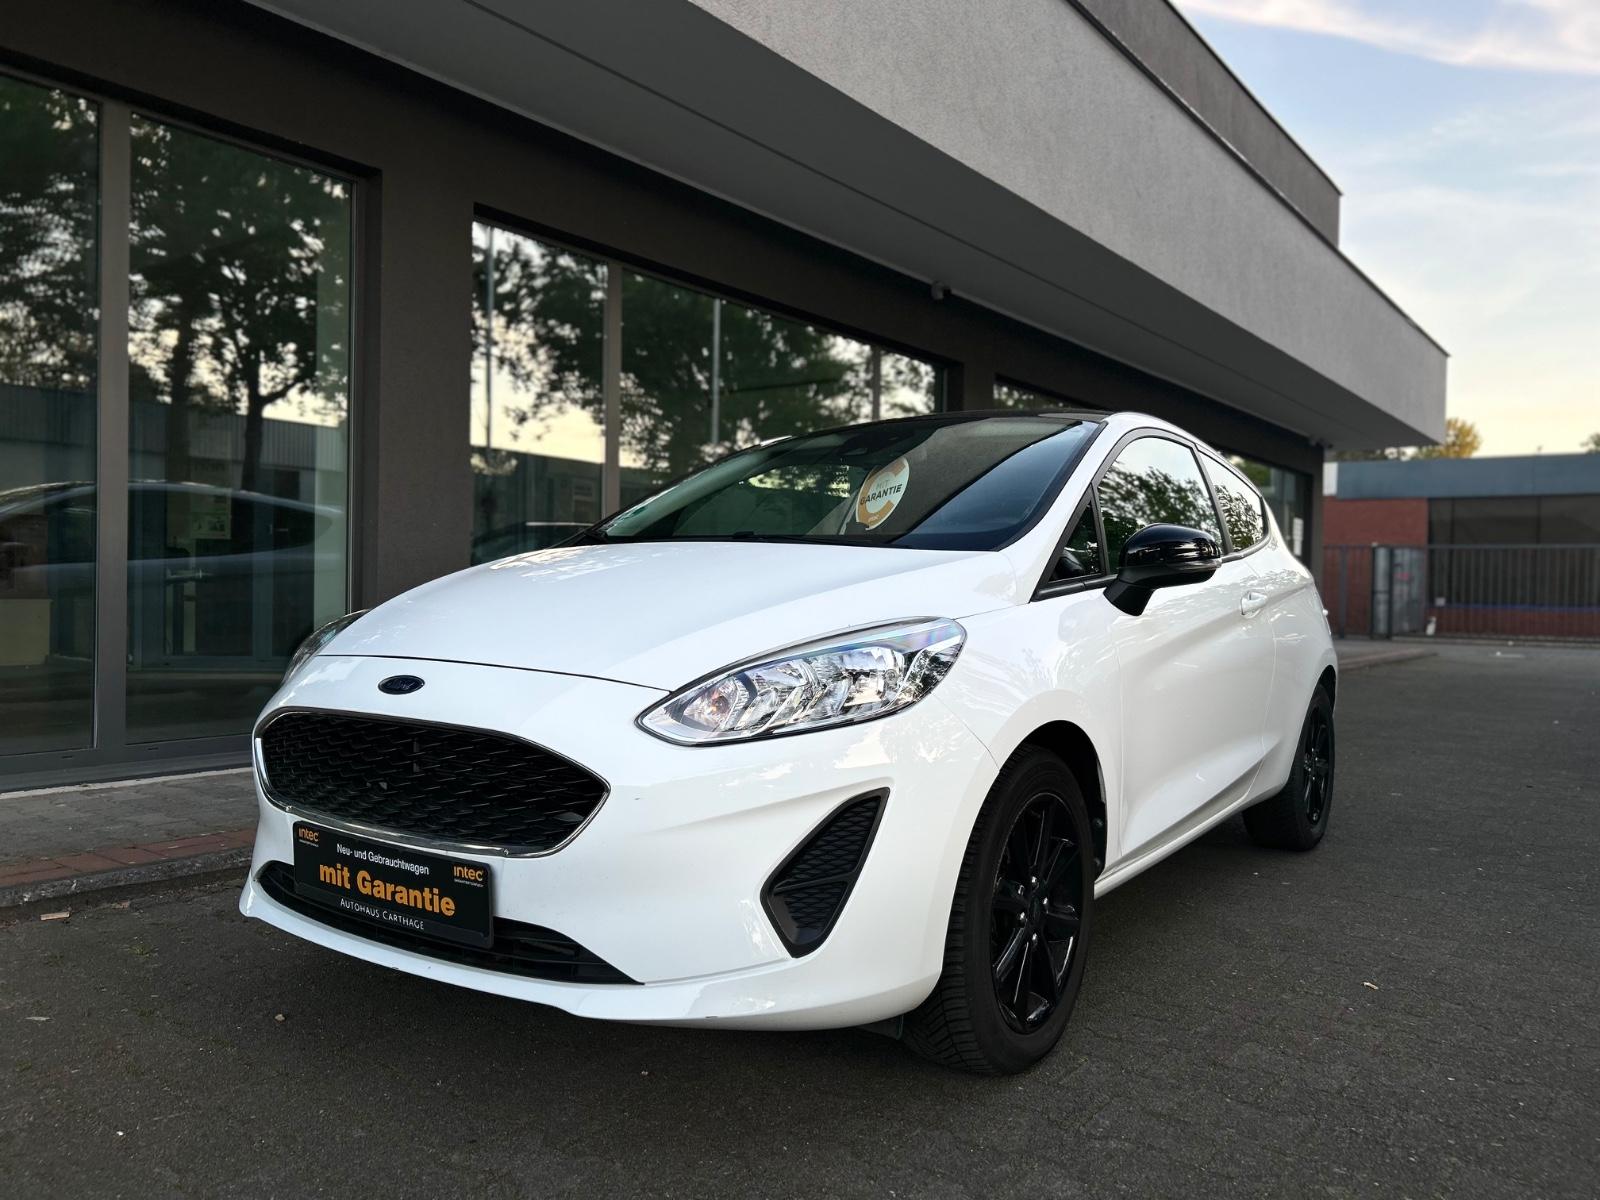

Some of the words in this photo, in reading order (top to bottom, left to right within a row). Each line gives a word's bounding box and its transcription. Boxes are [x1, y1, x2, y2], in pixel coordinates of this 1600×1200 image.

[860, 484, 903, 505] GARANTIE
[298, 827, 319, 842] intec
[336, 843, 353, 856] Neu-
[354, 849, 367, 860] und
[368, 851, 430, 876] Gebrauchtwagen
[453, 865, 483, 882] intec
[319, 863, 351, 889] mit
[356, 870, 456, 917] Garantie
[340, 898, 380, 918] AUTOHAUS
[382, 910, 424, 930] CARTHAGE
